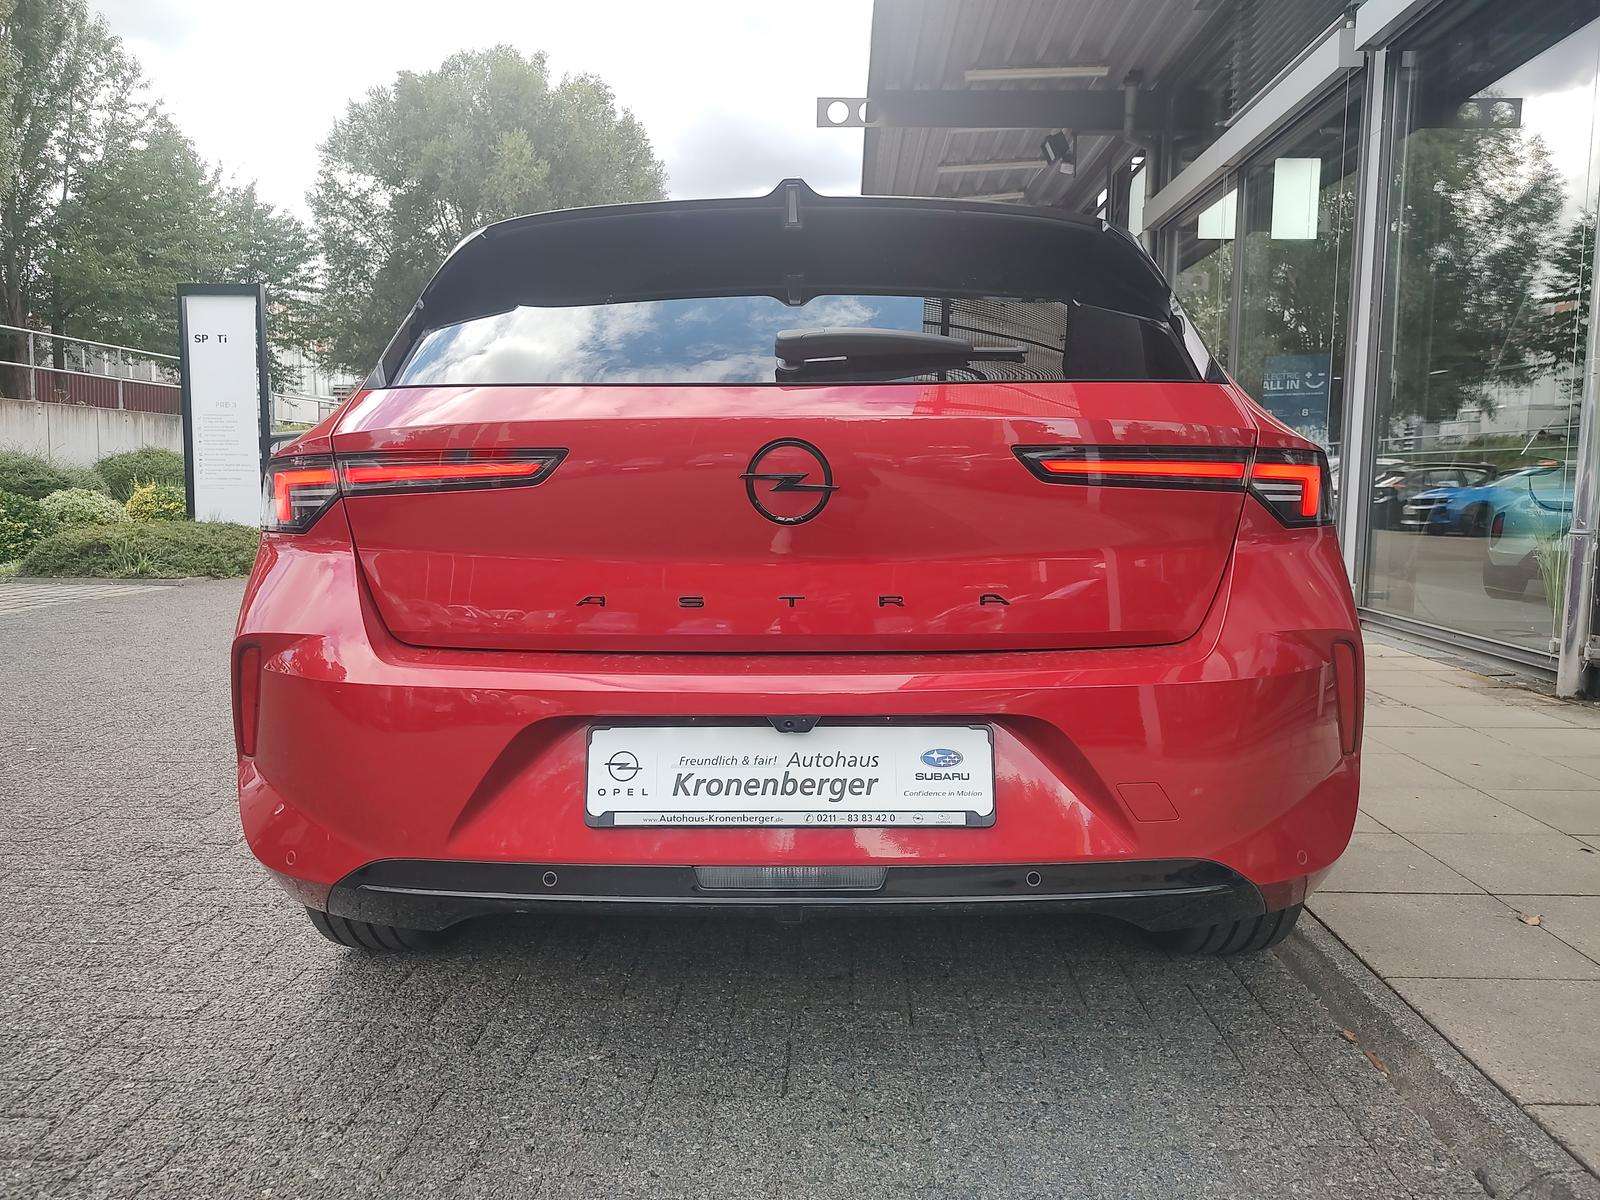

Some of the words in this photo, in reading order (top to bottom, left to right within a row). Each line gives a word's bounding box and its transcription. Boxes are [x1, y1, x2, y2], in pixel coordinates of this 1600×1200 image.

[1263, 380, 1284, 390] ALL
[1286, 379, 1300, 390] IN
[679, 755, 738, 766] Freundlich
[741, 756, 750, 766] &
[753, 755, 778, 767] fair!
[786, 751, 880, 768] Autohaus
[915, 772, 970, 781] SUBARU
[597, 788, 649, 796] OPEL
[672, 771, 880, 803] Kronenberger
[642, 814, 785, 824] www.Autohaus-Kronenberger.de
[816, 813, 837, 822] 0211
[847, 813, 859, 822] 83
[861, 813, 873, 822] 83
[875, 813, 887, 822] 42
[889, 813, 896, 822] 0
